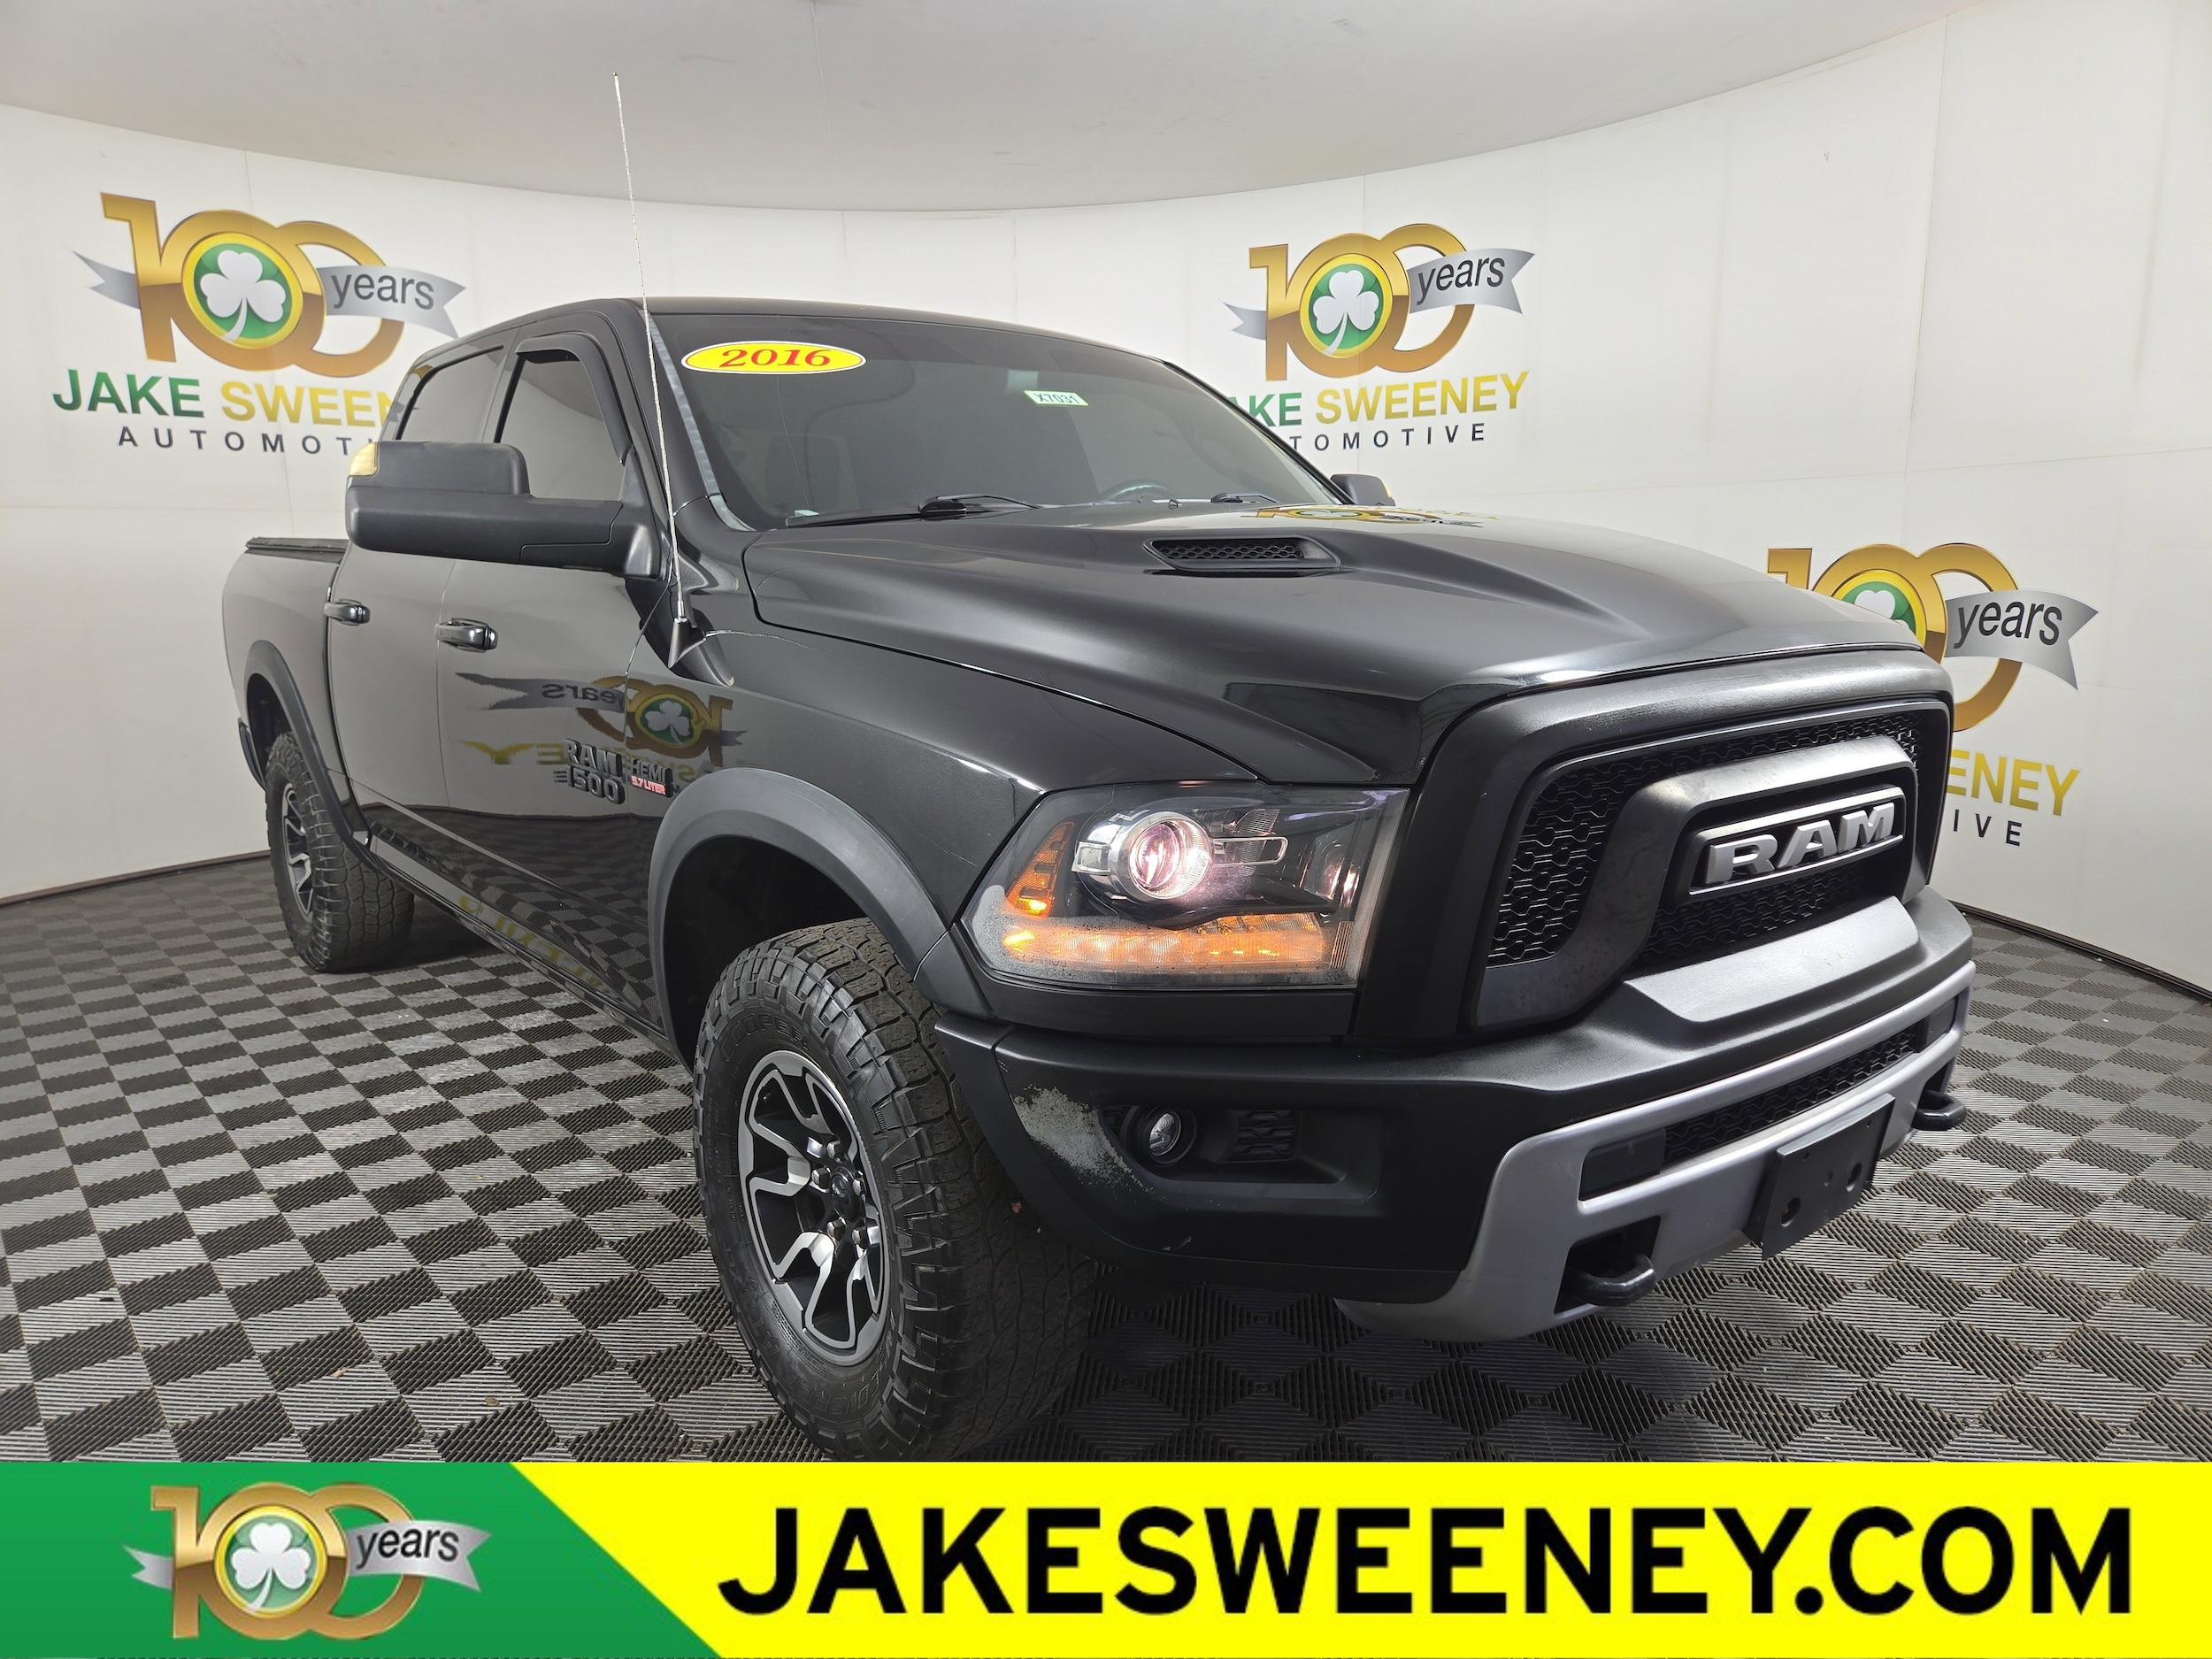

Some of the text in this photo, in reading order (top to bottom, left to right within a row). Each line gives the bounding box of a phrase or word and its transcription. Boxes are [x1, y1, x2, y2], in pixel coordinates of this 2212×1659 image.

[100, 192, 434, 378] 100 years
[1248, 223, 1506, 381] 100 years
[719, 349, 831, 368] 2016
[53, 368, 204, 419] JAKE
[1033, 393, 1080, 404] X7031
[1316, 371, 1530, 424] SWEENEY
[119, 426, 373, 456] AUTOMOT
[1954, 600, 2063, 649] years
[564, 738, 622, 777] RAM
[632, 759, 668, 784] HEMI
[567, 764, 625, 804] 1500
[1706, 803, 1895, 885] RAM
